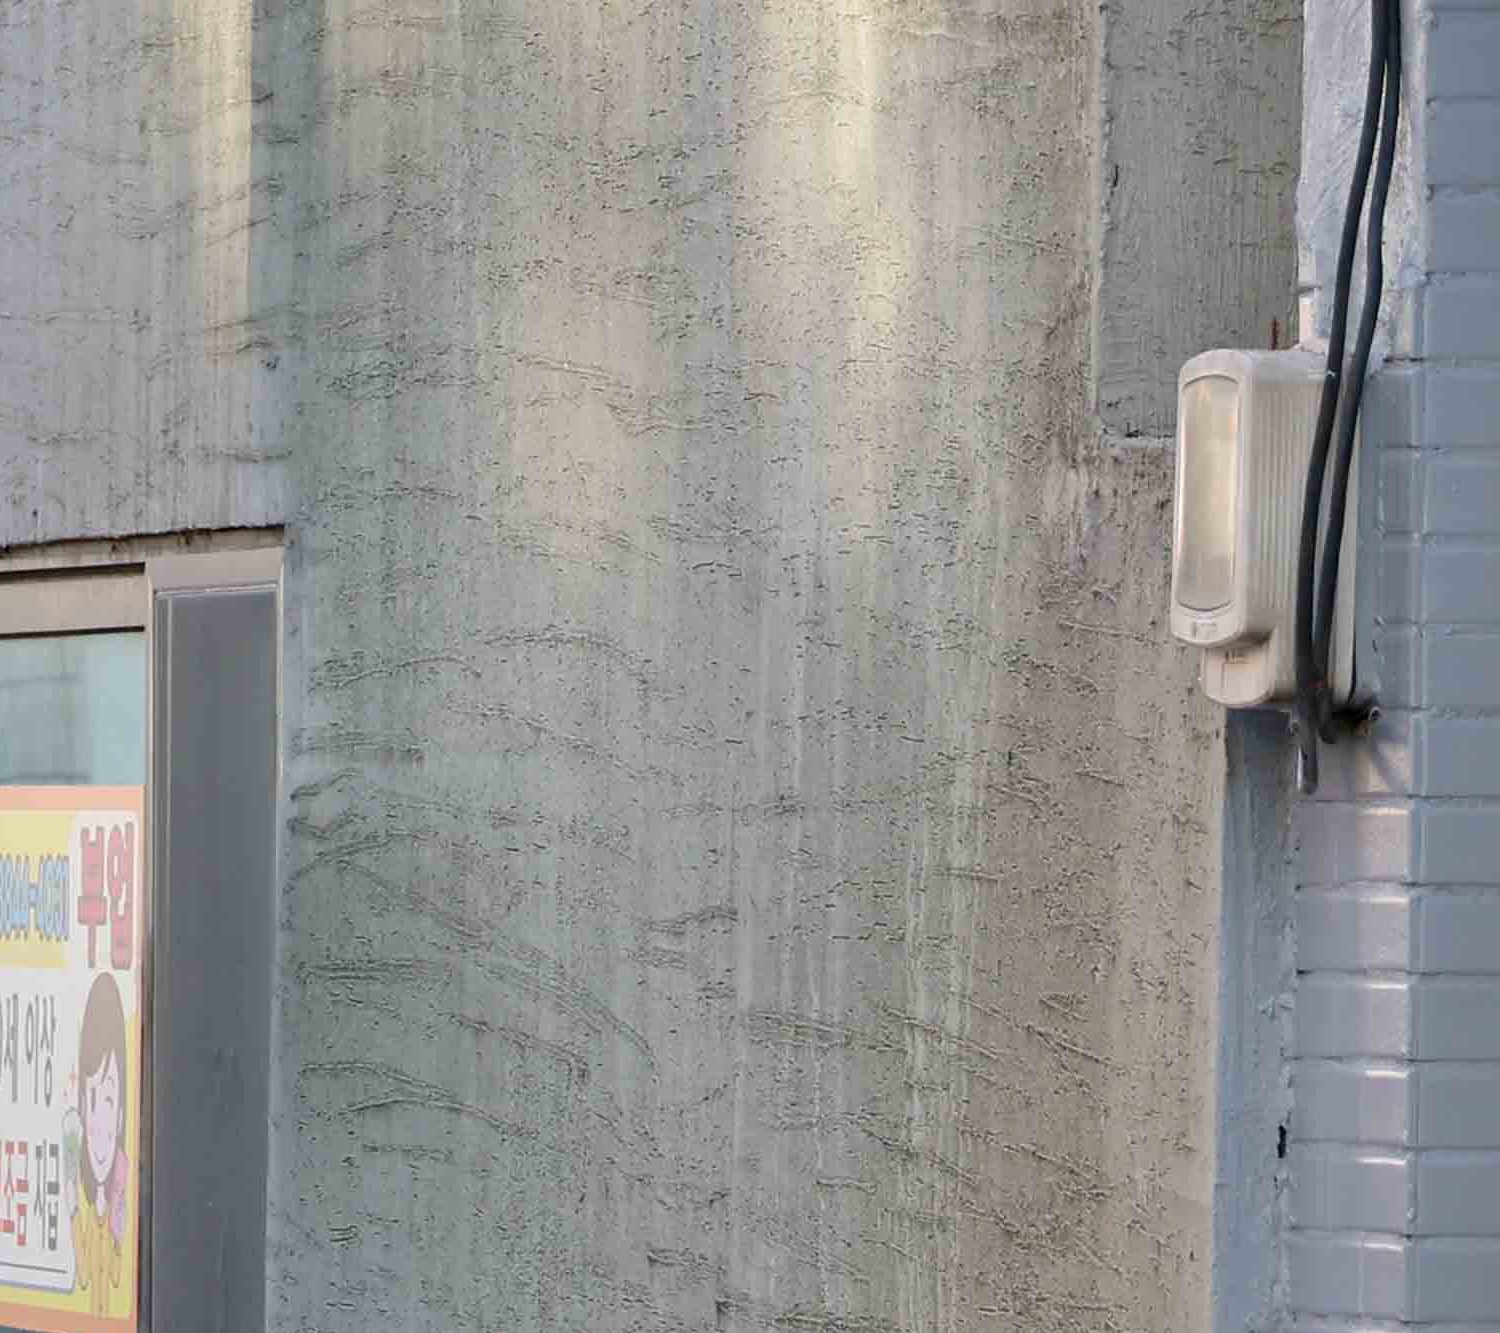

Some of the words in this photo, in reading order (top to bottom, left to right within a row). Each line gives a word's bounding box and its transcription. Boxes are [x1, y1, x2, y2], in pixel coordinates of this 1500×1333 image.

[77, 821, 135, 971] 부업
[25, 993, 59, 1109] 이상
[34, 1138, 61, 1251] 지급
